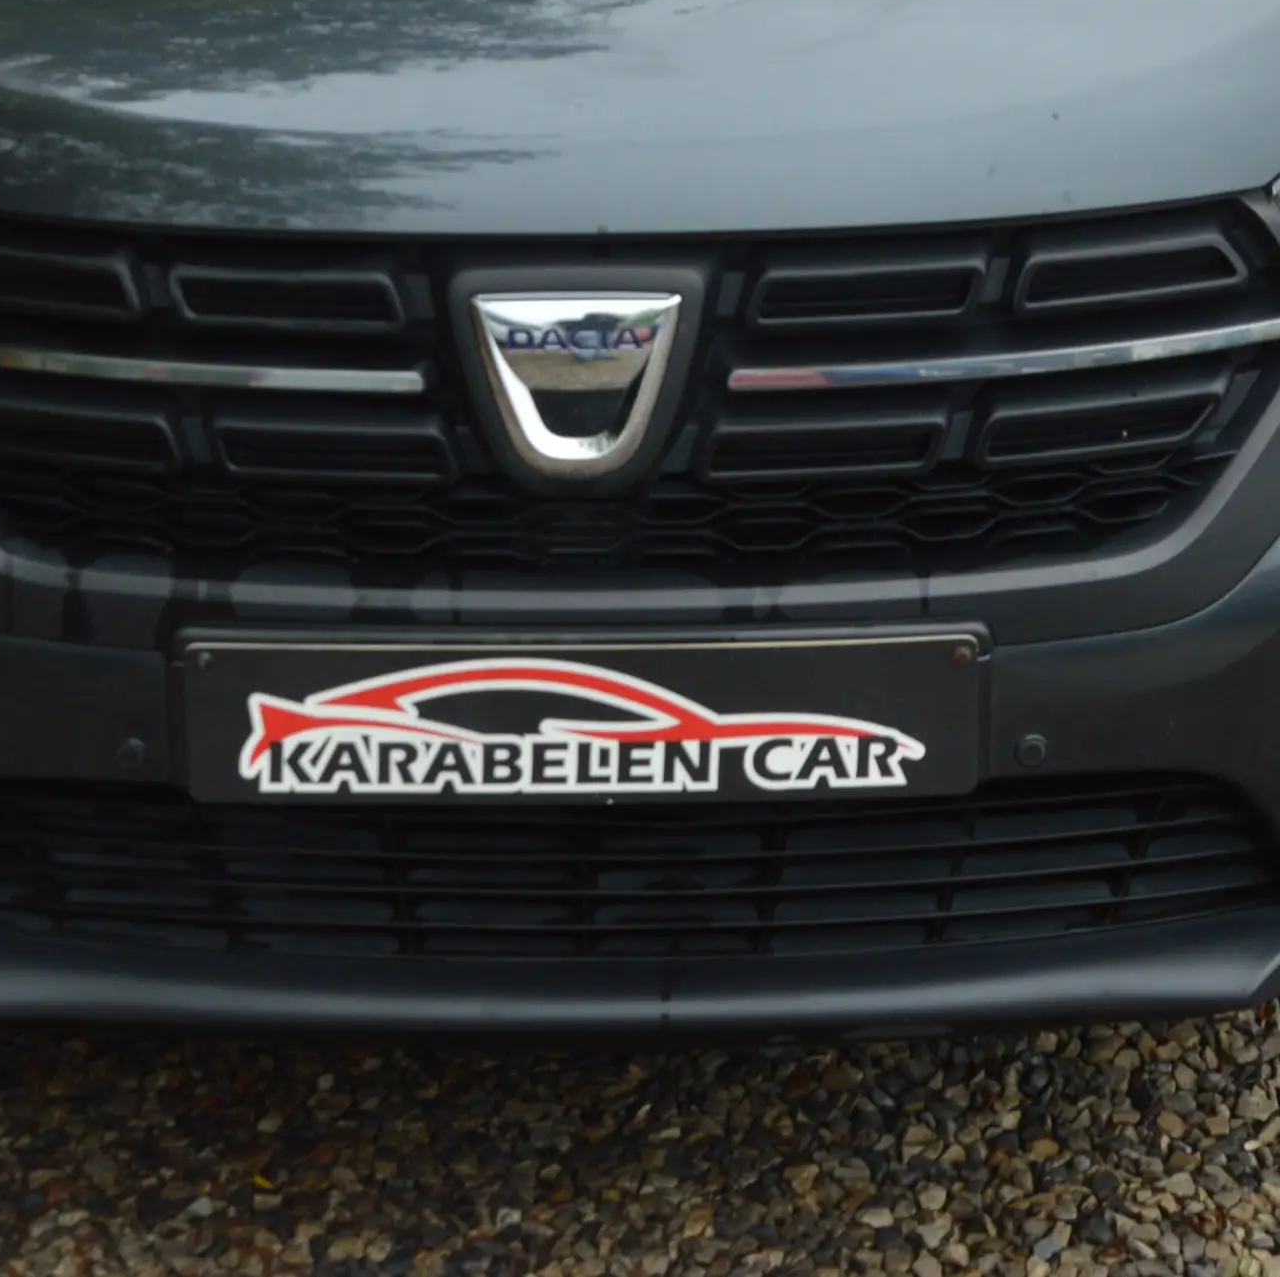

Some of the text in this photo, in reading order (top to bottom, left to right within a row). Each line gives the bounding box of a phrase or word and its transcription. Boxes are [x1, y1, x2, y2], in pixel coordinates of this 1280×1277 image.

[506, 328, 643, 350] DACIA
[267, 736, 902, 785] KARABELEN CAR
